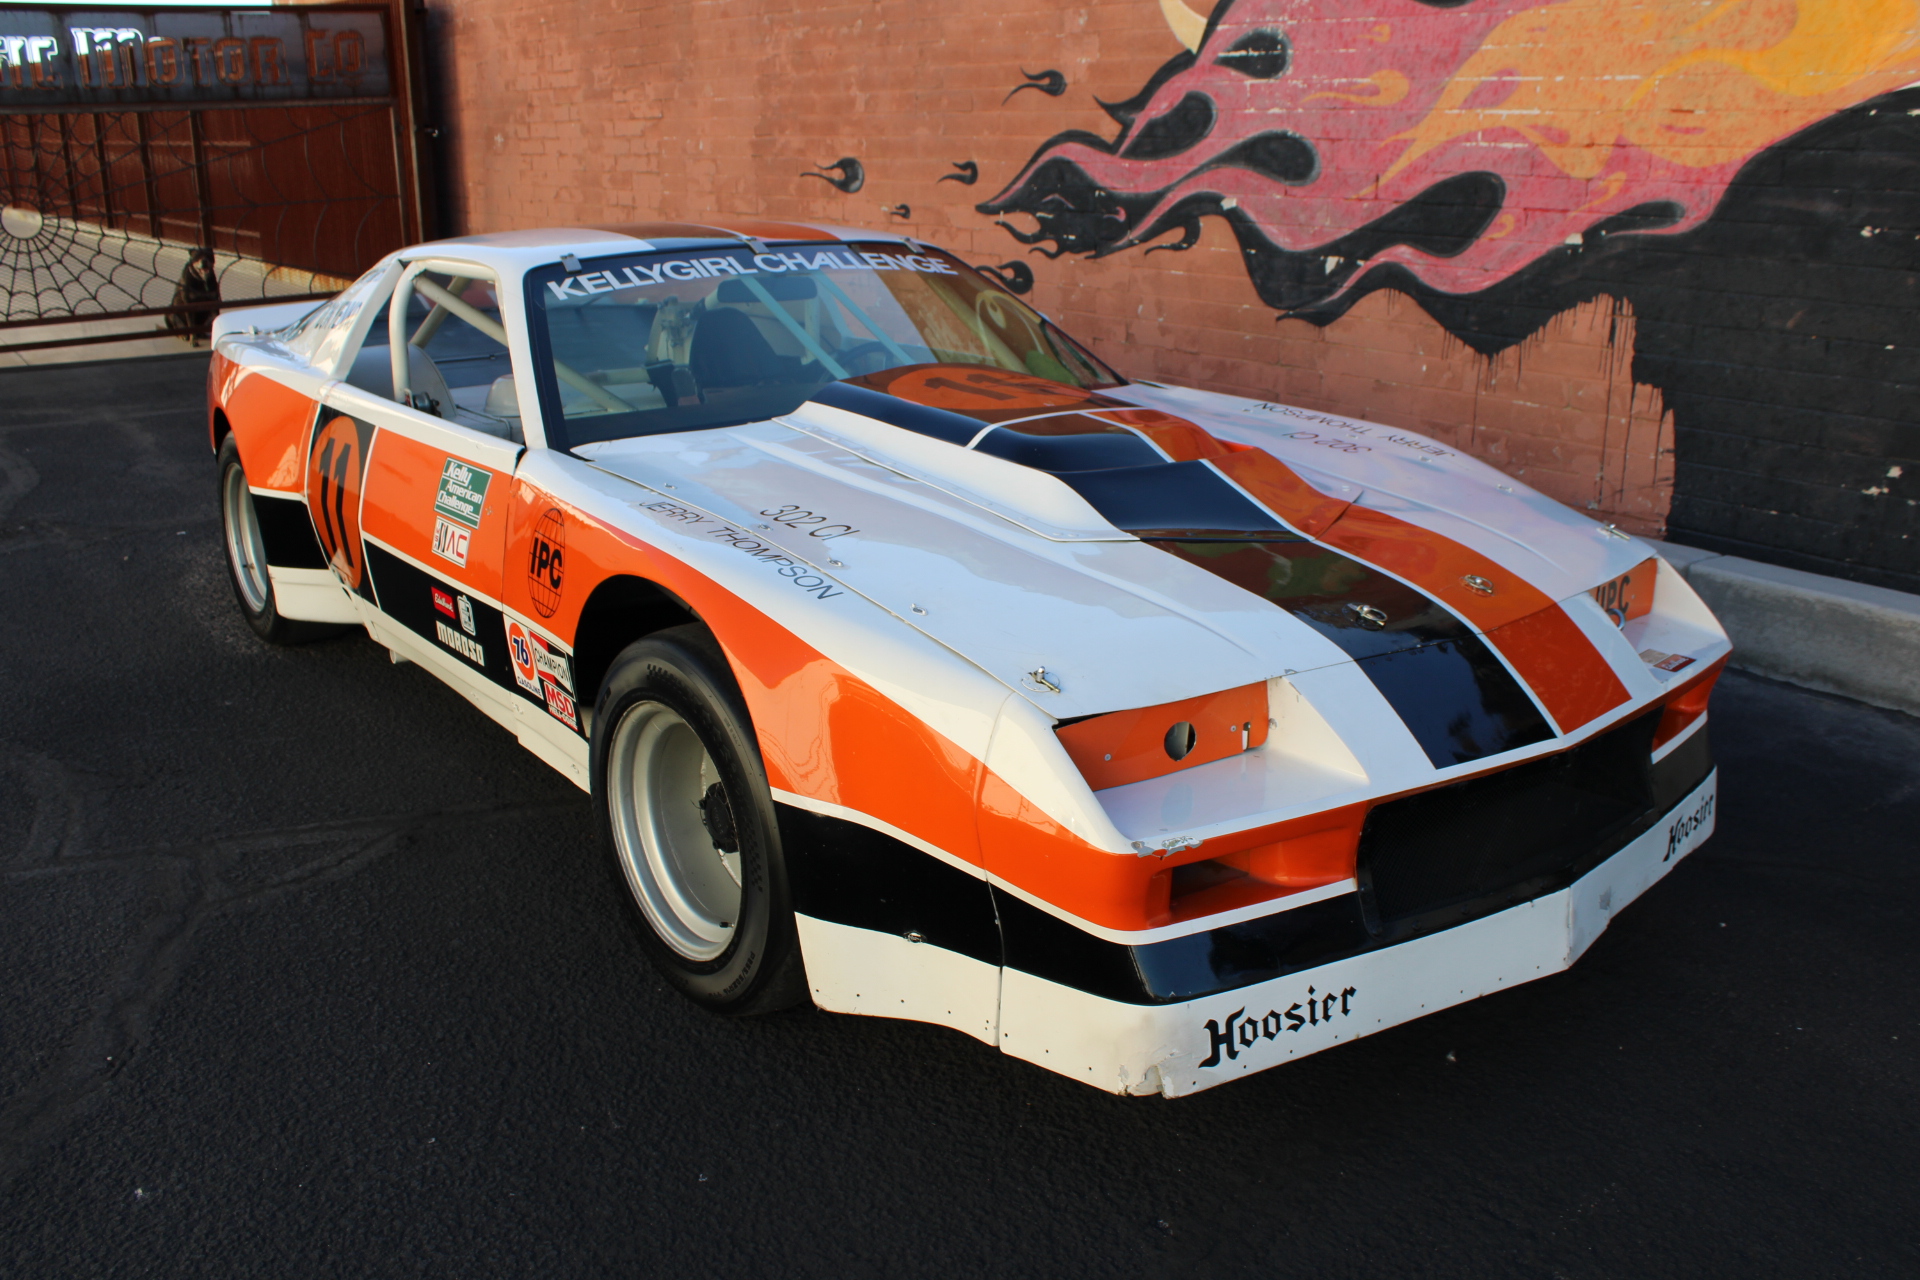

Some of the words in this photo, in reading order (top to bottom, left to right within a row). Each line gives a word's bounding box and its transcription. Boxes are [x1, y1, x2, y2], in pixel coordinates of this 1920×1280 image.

[753, 252, 959, 276] CHALLENGE
[1379, 433, 1456, 458] JERRY
[445, 480, 483, 504] American
[447, 461, 473, 487] Kelly
[318, 436, 354, 570] 11
[437, 489, 474, 514] Challenge
[759, 504, 828, 529] 302
[808, 523, 861, 541] CI
[530, 536, 563, 590] IPC
[638, 501, 715, 525] JERRY
[706, 525, 845, 600] THOMPSON
[435, 620, 486, 667] MOROSO
[512, 636, 530, 667] 76
[534, 647, 572, 683] CHAMPION
[517, 676, 541, 697] GASOLINE
[545, 683, 575, 719] MSD
[1662, 794, 1714, 863] Hoosier
[1198, 984, 1357, 1069] Hoosier
